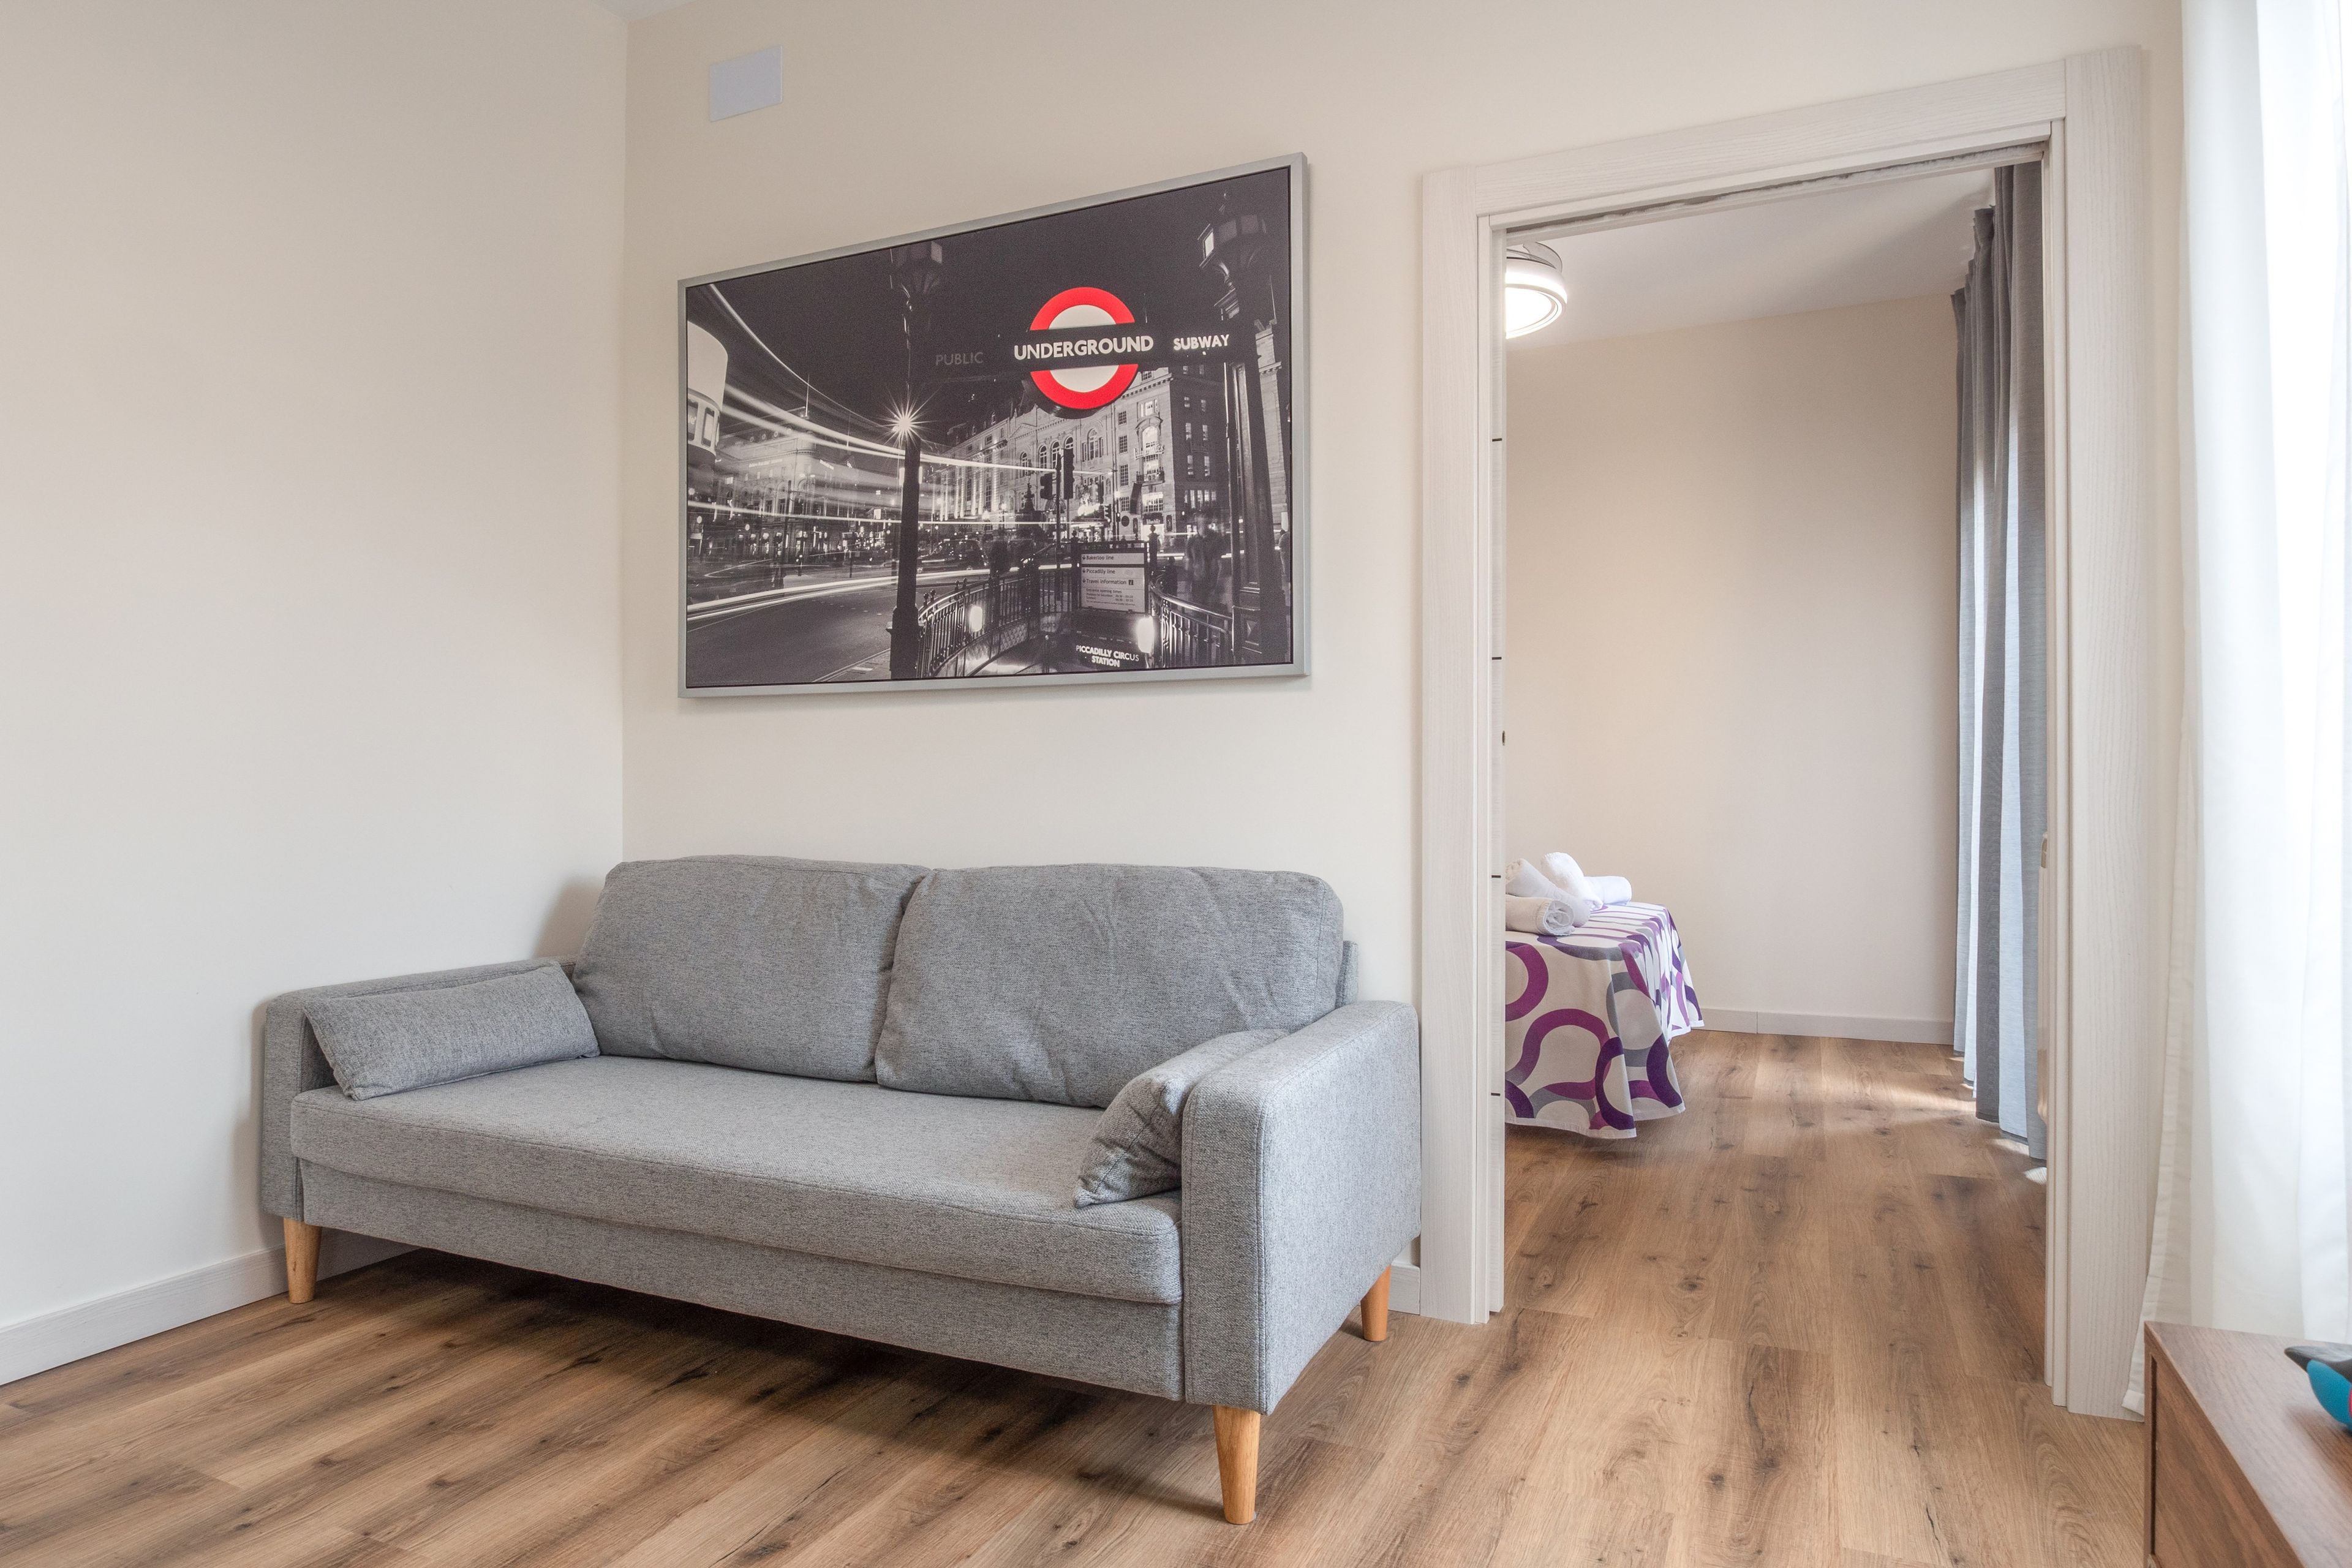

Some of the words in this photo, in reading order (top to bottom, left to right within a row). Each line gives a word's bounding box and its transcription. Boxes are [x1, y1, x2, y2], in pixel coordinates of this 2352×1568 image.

[1014, 335, 1154, 360] UNDERGROUND
[1173, 334, 1230, 351] SUBWAY
[935, 352, 984, 366] PUBLIC
[1076, 645, 1112, 658] PICCADILLY
[1113, 650, 1139, 662] CIRCUS
[1091, 655, 1120, 668] STATION
